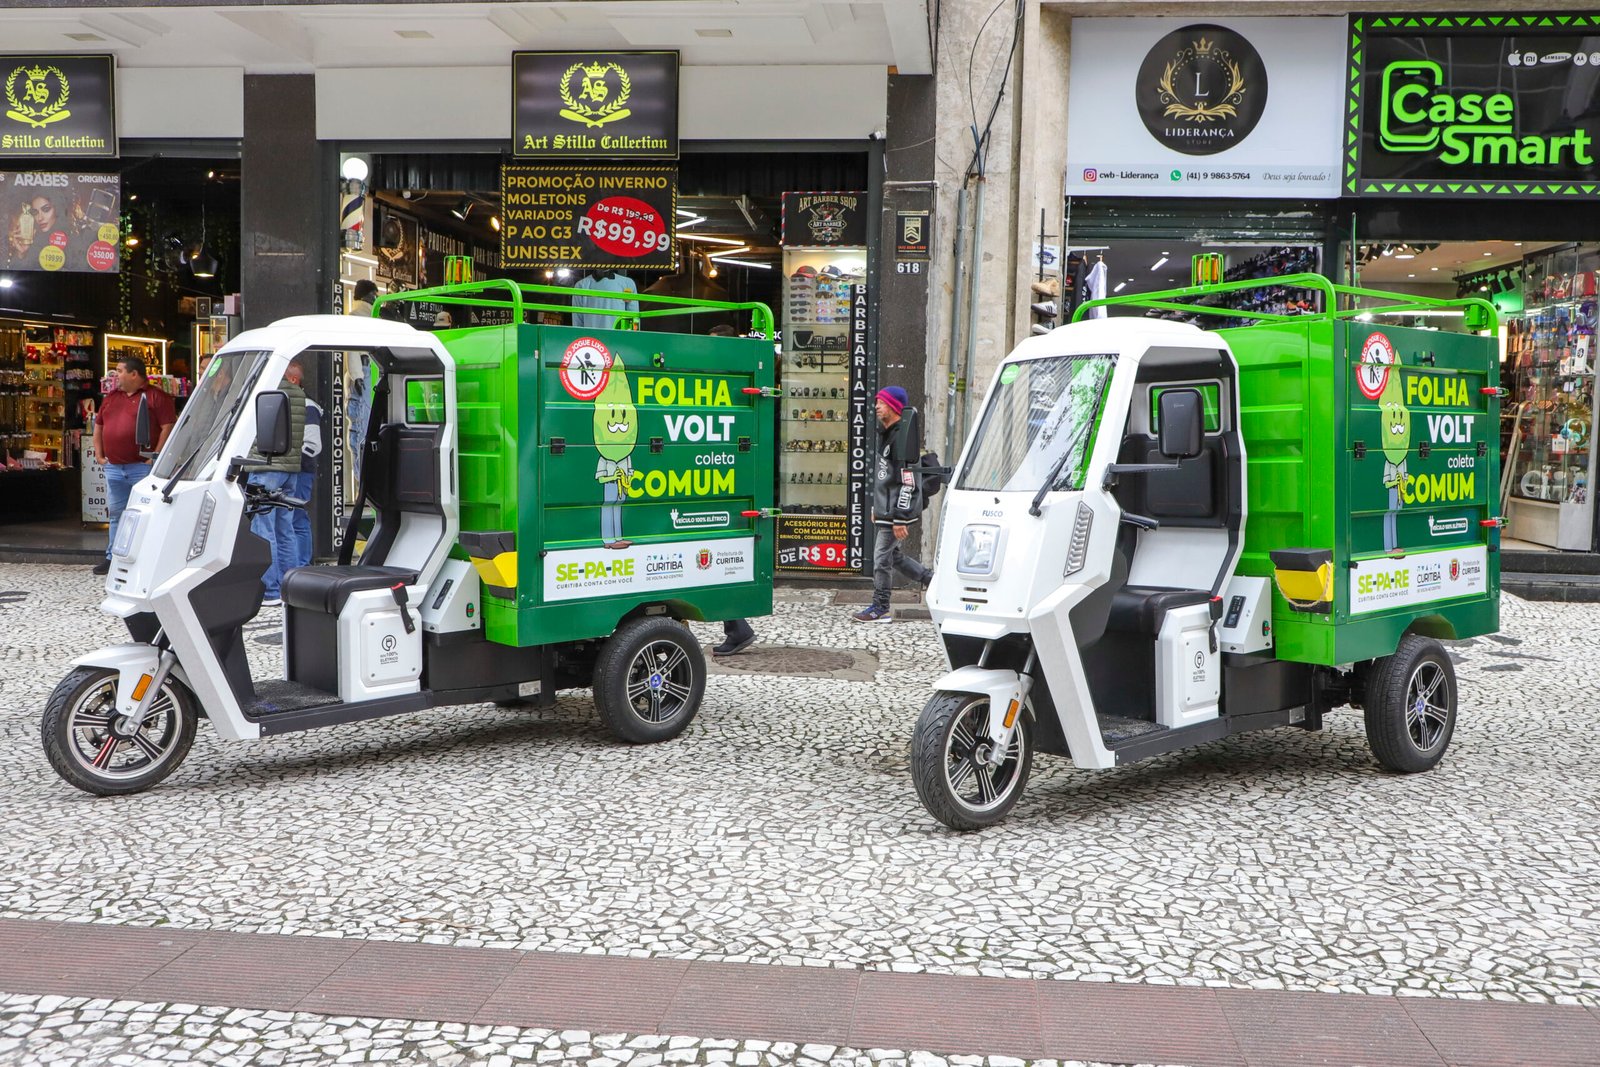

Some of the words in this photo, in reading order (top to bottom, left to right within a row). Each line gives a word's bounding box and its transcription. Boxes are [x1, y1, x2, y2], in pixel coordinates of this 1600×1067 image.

[1195, 72, 1209, 97] L
[1392, 84, 1513, 123] Case
[1165, 127, 1235, 139] LIDERANÇA
[2, 135, 40, 148] Stillo
[45, 135, 105, 148] Collection
[523, 135, 548, 149] Art
[553, 134, 596, 149] Stillo
[601, 135, 668, 149] Collection
[1439, 124, 1594, 165] Smart
[77, 175, 119, 184] ORIGINAIS
[1099, 171, 1115, 179] cwb
[1120, 171, 1159, 180] Liderança
[1186, 171, 1200, 181] (41)
[1203, 172, 1209, 180] 9
[1211, 172, 1250, 180] 9863-5764
[1263, 172, 1281, 181] Deus
[1282, 174, 1296, 183] seja
[1297, 172, 1324, 181] louvado
[508, 174, 595, 191] PROMOÇÃO
[599, 176, 668, 189] INVERNO
[507, 193, 587, 205] MOLETONS
[798, 196, 811, 213] ART
[813, 195, 839, 205] BARBER
[840, 195, 857, 211] SHOP
[507, 209, 573, 220] VARIADOS
[597, 203, 610, 213] De
[611, 206, 624, 216] R$
[507, 226, 518, 239] P
[521, 226, 546, 239] AO
[551, 226, 572, 239] G3
[577, 215, 670, 252] R$99,99
[507, 246, 582, 259] UNISSEX
[897, 262, 920, 273] 618
[853, 284, 867, 391] BARBEARIA
[563, 351, 573, 367] NÃO
[572, 339, 591, 352] JOGUE
[591, 340, 604, 353] LIXO
[637, 376, 732, 407] FOLHA
[1407, 376, 1470, 406] FOLHA
[664, 415, 735, 442] VOLT
[1427, 415, 1475, 443] VOLT
[695, 452, 735, 465] coleta
[1448, 454, 1475, 468] coleta
[627, 468, 735, 498] COMUM
[1404, 472, 1475, 504] COMUM
[676, 516, 694, 524] VEÍCULO
[982, 510, 1003, 518] FUSCO
[850, 482, 864, 569] PIERCING
[716, 556, 744, 564] CURITIBA
[780, 552, 796, 564] DE
[799, 546, 821, 562] R$
[556, 558, 635, 582] SE-PA-RE
[646, 560, 683, 572] CURITIBA
[1462, 567, 1480, 575] CURITIBA
[1358, 569, 1409, 594] SE-PA-RE
[1417, 571, 1441, 584] CURITIBA
[557, 582, 582, 590] CURITIBA
